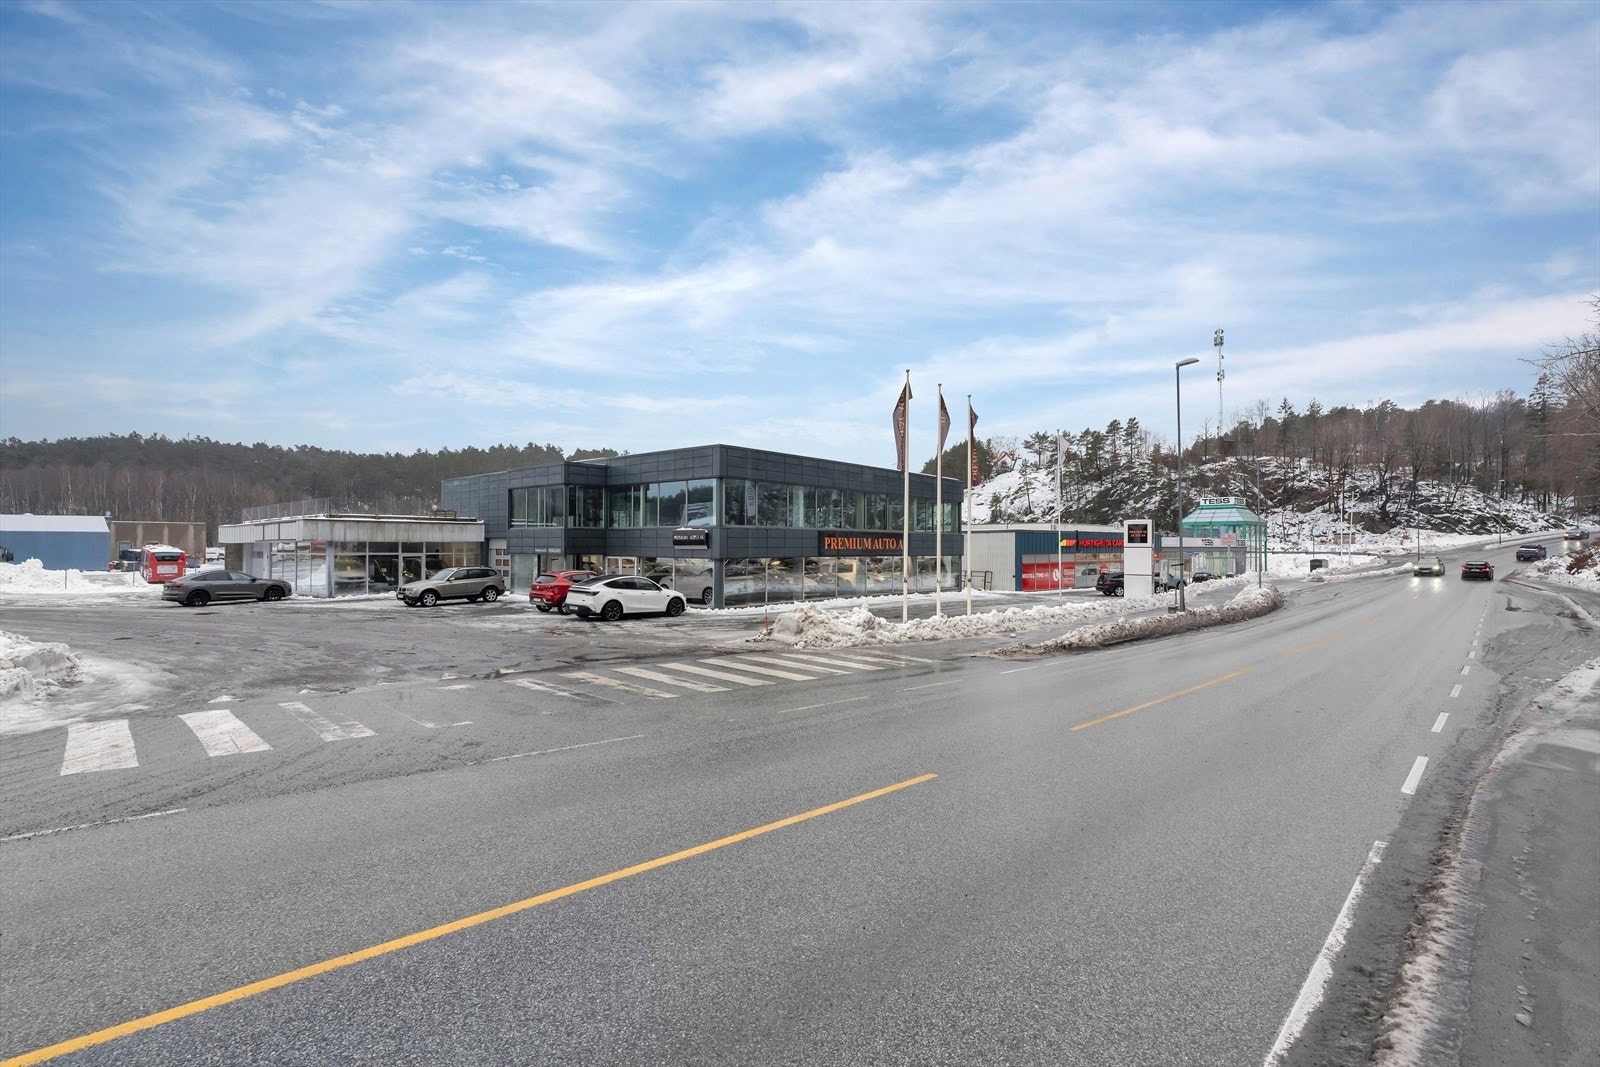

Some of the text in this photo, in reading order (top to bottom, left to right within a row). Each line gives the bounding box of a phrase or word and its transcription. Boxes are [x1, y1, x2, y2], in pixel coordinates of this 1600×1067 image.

[1201, 497, 1230, 505] TESS
[824, 537, 872, 550] PREMIUM
[873, 538, 896, 550] AUTO
[1078, 539, 1112, 547] HURTIGRUTA
